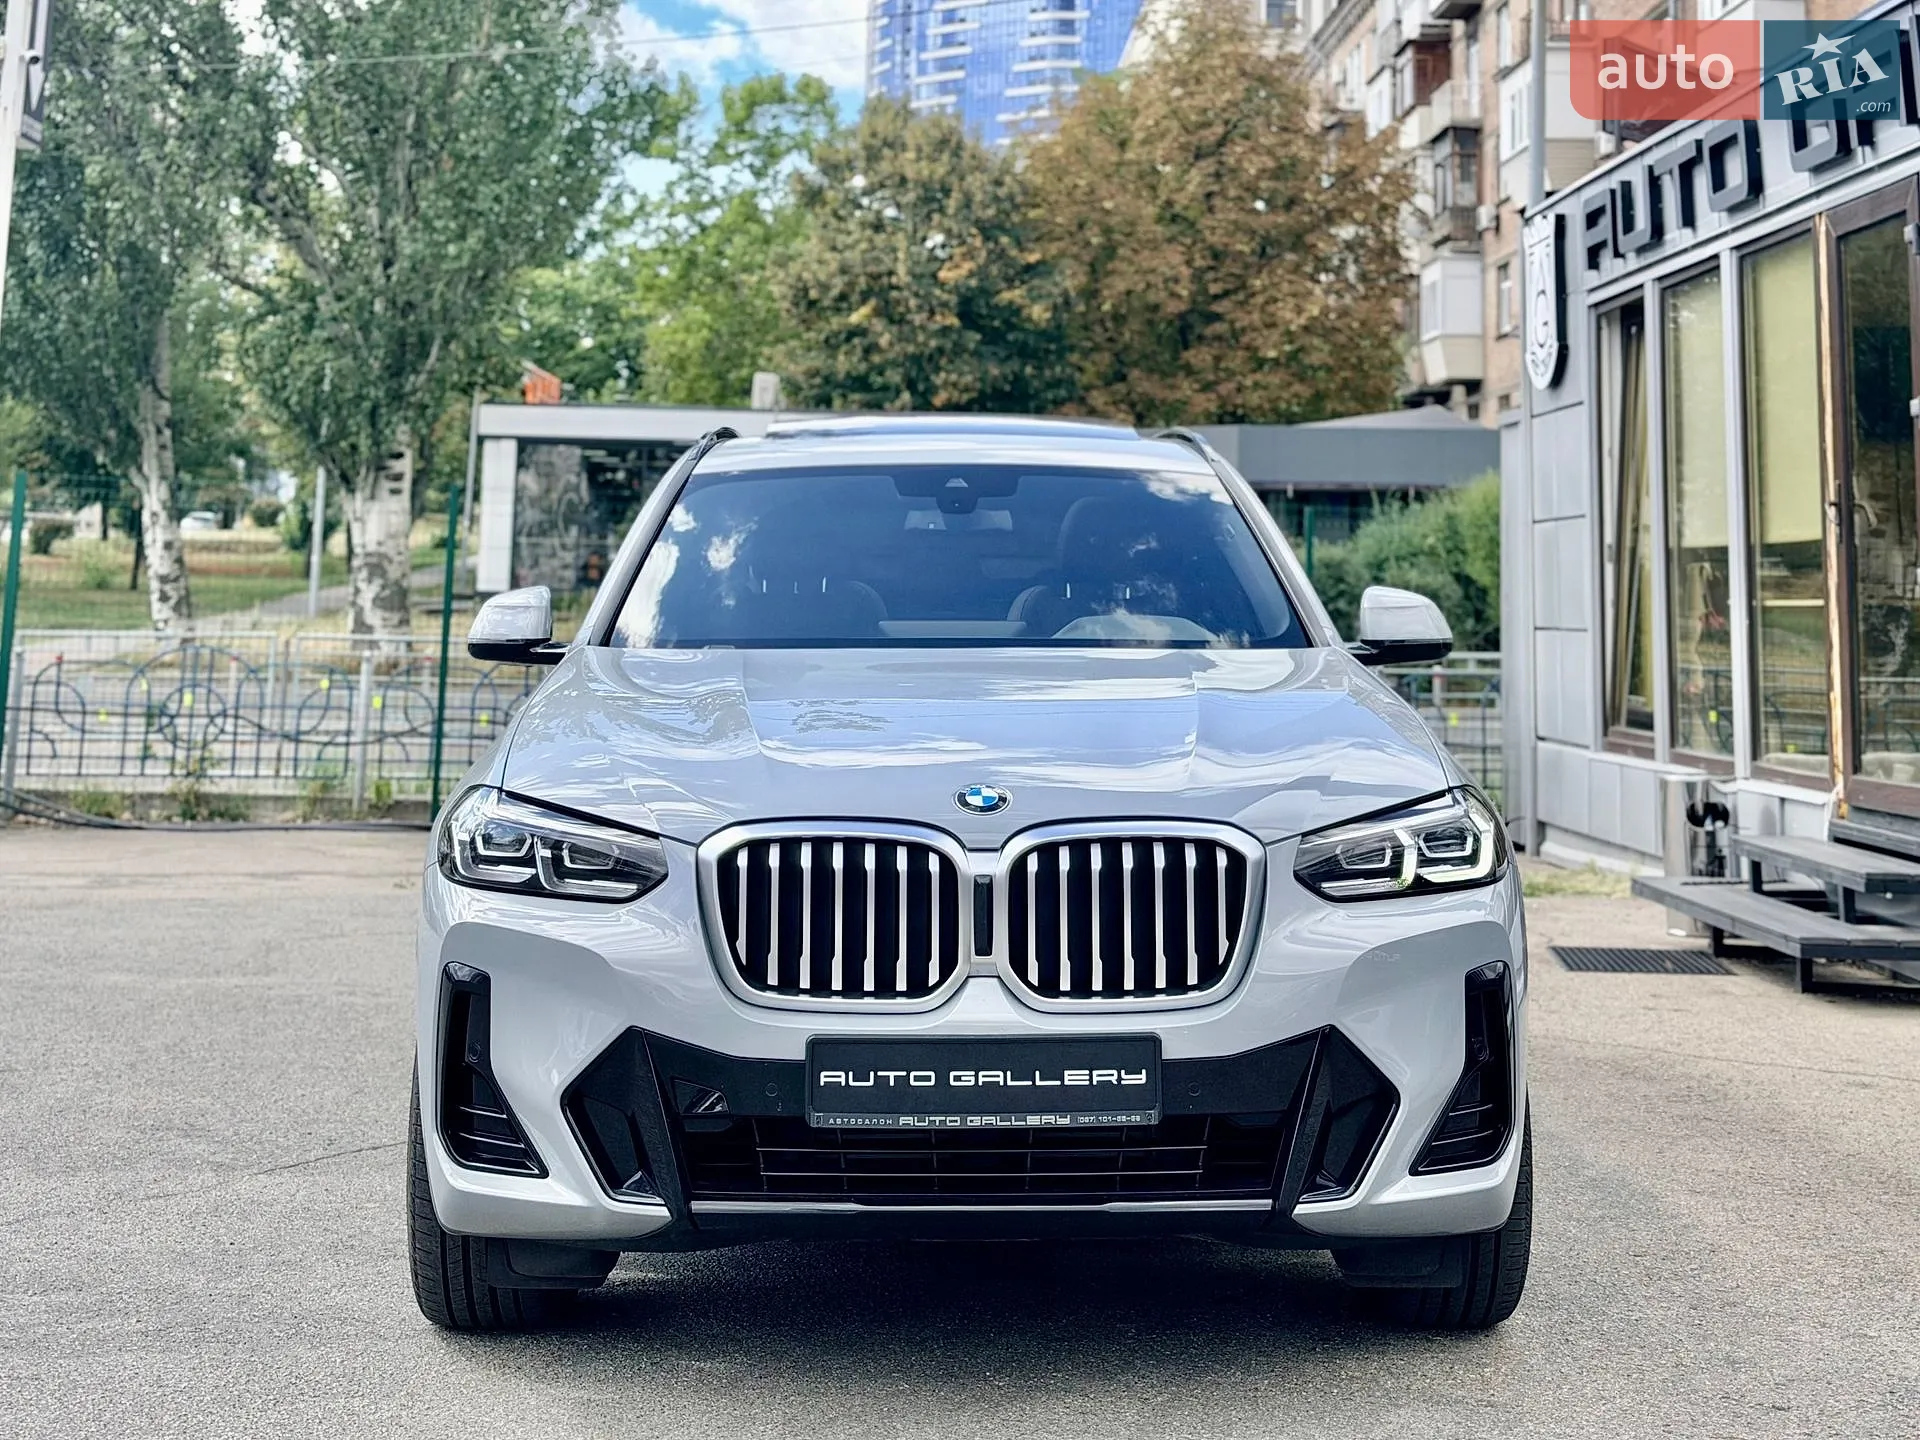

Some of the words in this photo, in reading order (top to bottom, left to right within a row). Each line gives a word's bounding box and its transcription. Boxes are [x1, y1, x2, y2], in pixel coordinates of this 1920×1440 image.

[1582, 116, 1764, 270] AUTO
[819, 1071, 936, 1087] AUTO
[949, 1069, 1147, 1086] GALLERY
[899, 1116, 960, 1126] AUTO
[966, 1115, 1070, 1126] GALLERY
